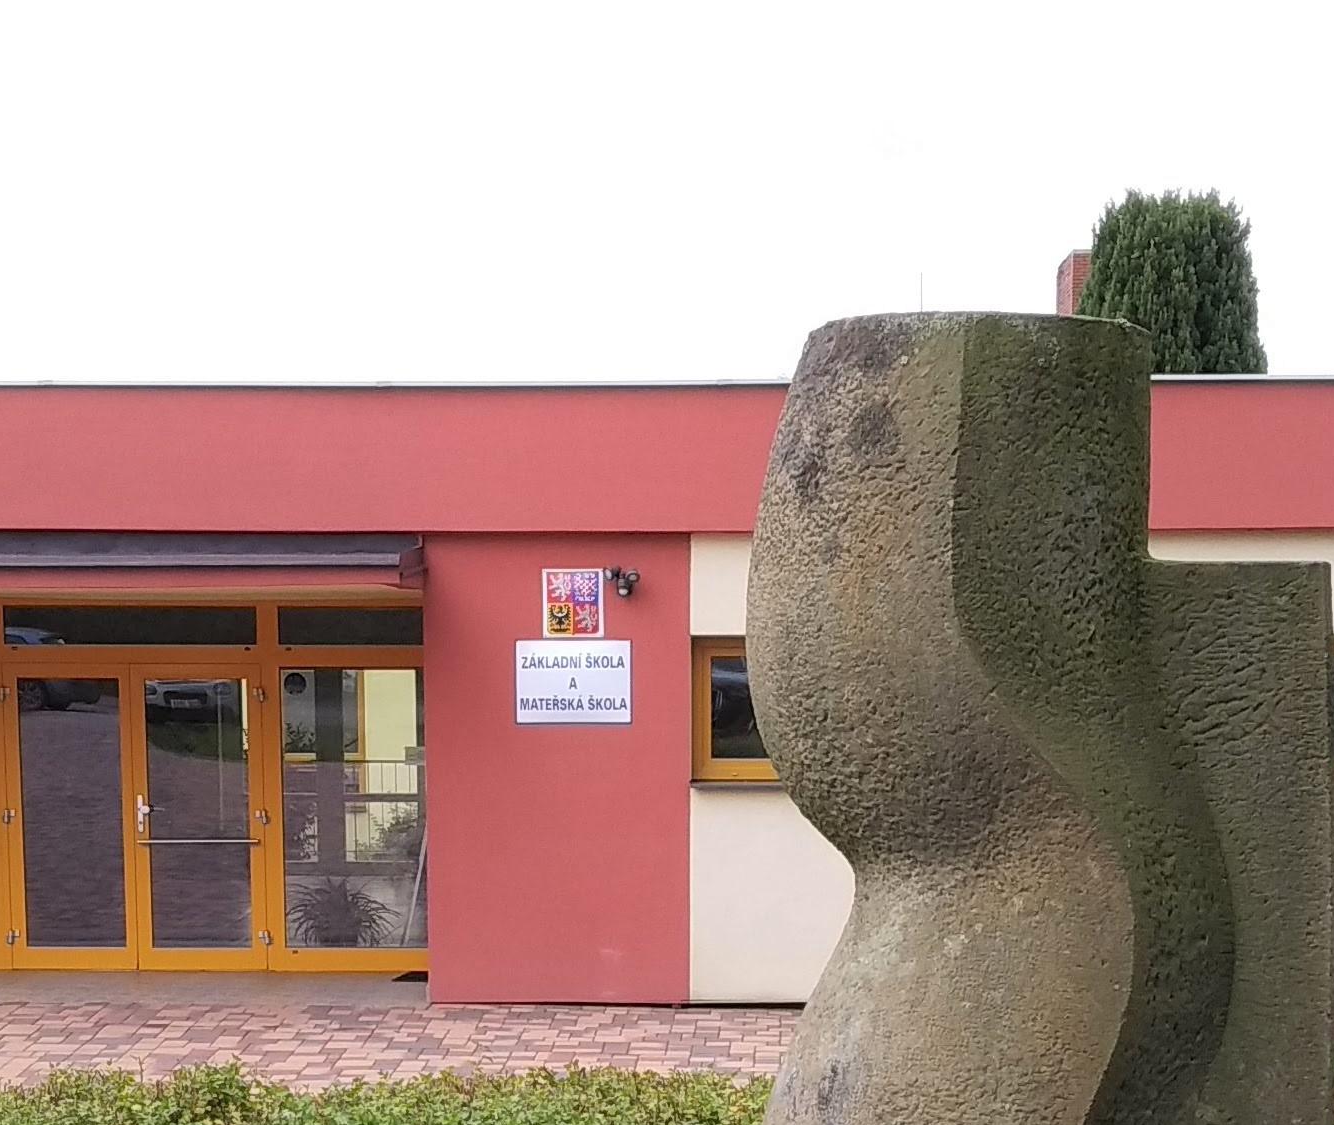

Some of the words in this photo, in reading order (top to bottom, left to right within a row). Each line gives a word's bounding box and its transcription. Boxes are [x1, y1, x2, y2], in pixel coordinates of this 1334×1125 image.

[521, 653, 582, 669] ZÁKLADNÍ
[585, 653, 625, 669] ŠKOLA
[569, 677, 578, 690] A
[520, 695, 584, 711] MATEŘSKÁ
[587, 695, 628, 711] ŠKOLA
